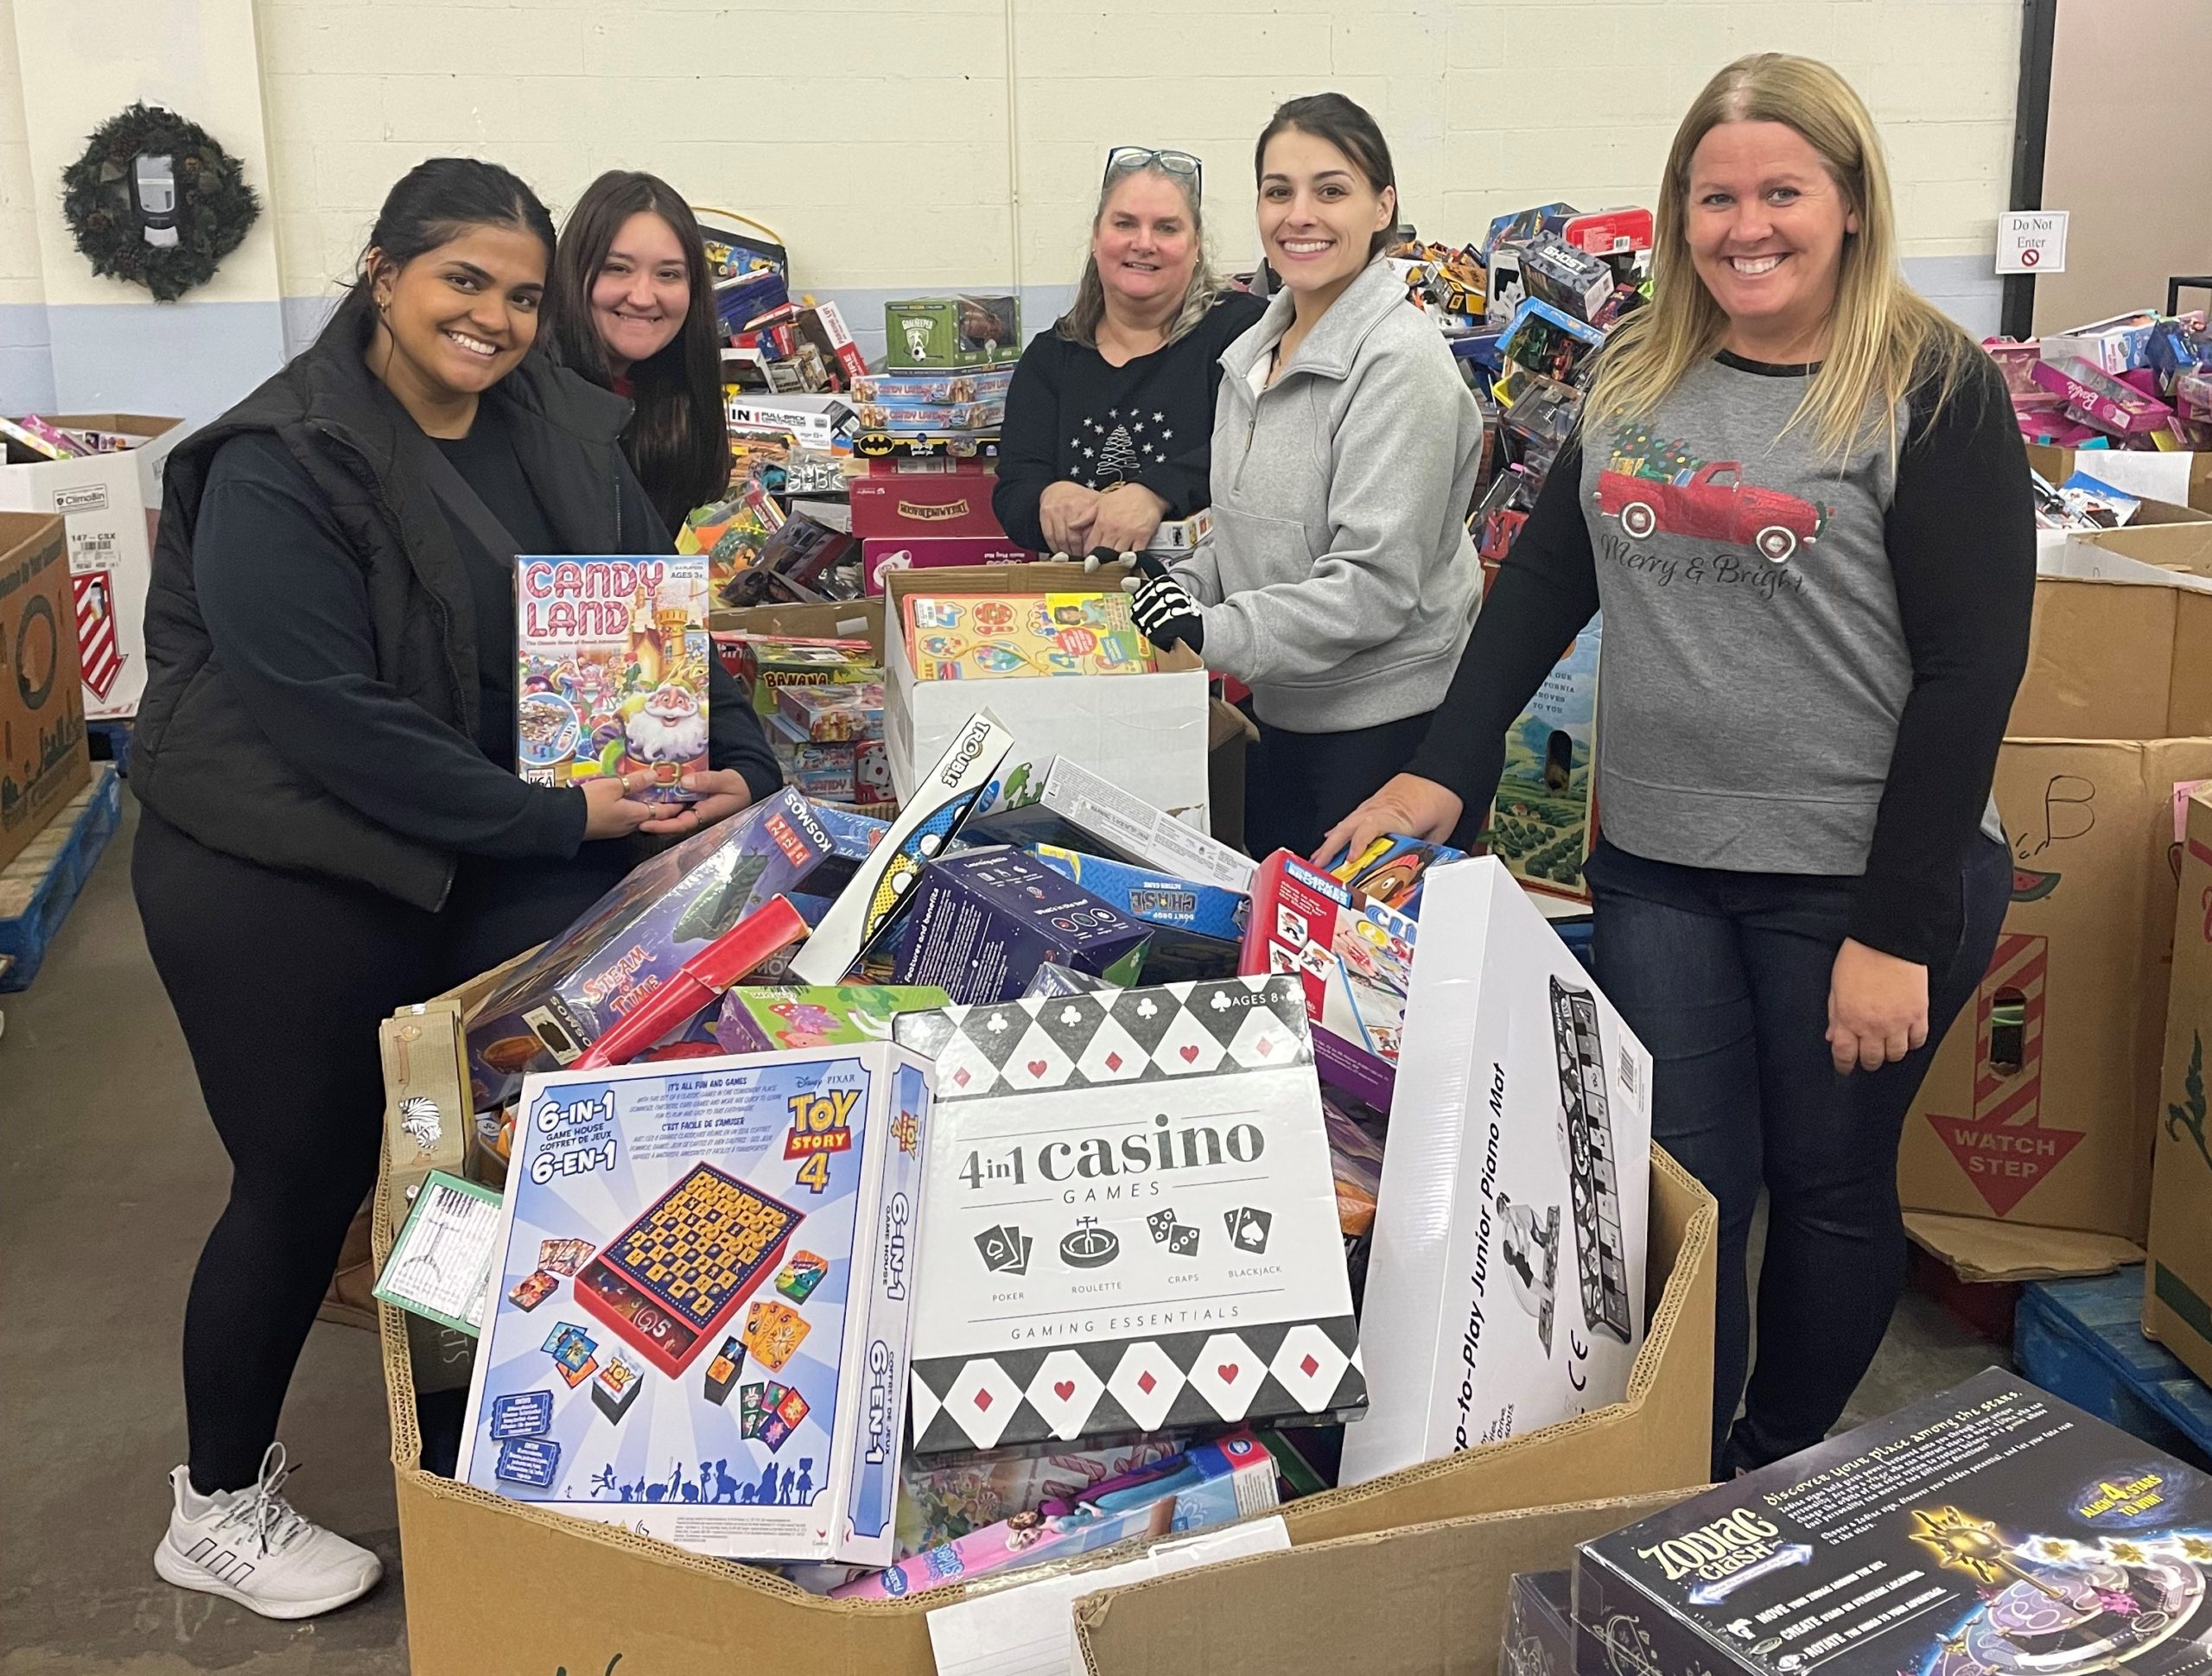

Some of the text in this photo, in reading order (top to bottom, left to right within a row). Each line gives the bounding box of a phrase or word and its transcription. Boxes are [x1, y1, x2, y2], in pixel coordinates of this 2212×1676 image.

[2012, 218, 2053, 232] Do Not
[2017, 236, 2046, 249] Enter
[1543, 244, 1588, 272] GHOST
[2066, 380, 2099, 411] Barbie
[732, 409, 806, 422] IN 1 PULL-BACK
[1601, 532, 1808, 600] Merry & Bright
[526, 562, 664, 599] CANDY
[526, 601, 630, 638] LAND
[764, 670, 829, 689] BANANA
[1533, 702, 1563, 714] TO YOU
[941, 721, 991, 789] TROUBLE
[784, 793, 832, 853] KOSMOS
[2044, 774, 2096, 848] B
[1130, 890, 1198, 913] CHASE
[905, 887, 940, 983] Features and benefits
[582, 944, 658, 1005] STEAM
[609, 974, 663, 1017] TIME
[1232, 992, 1267, 1006] AGES
[550, 996, 593, 1047] OSMOS
[681, 1081, 693, 1090] ALL
[696, 1080, 708, 1089] FUN
[709, 1079, 722, 1088] AND
[726, 1076, 747, 1086] GAMES
[795, 1074, 855, 1089] Disney PIXAR
[1491, 1063, 1506, 1113] Mat
[537, 1089, 615, 1133] 6-IN-1
[704, 1119, 713, 1127] DE
[787, 1089, 864, 1134] TOY
[540, 1131, 612, 1152] COFFRET DE JEUX
[546, 1123, 604, 1141] GAME HOUSE
[791, 1132, 847, 1152] STORY
[1955, 1128, 2056, 1157] WATCH
[531, 1139, 617, 1185] 6-EN-1
[1037, 1113, 1265, 1183] casino
[795, 1150, 831, 1195] 4
[1483, 1124, 1501, 1203] Piano
[1969, 1156, 2039, 1179] STEP
[1064, 1180, 1160, 1204] GAMES
[887, 1191, 909, 1302] 6-IN-1
[1471, 1204, 1493, 1298] Junior
[1167, 1273, 1199, 1285] CRAPS
[1228, 1264, 1282, 1278] BLACKJACK
[992, 1292, 1025, 1302] POKER
[1071, 1281, 1122, 1294] ROULETTE
[652, 1318, 672, 1337] 5
[1011, 1305, 1240, 1341] GAMING ESSENTIALS
[1567, 1328, 1588, 1392] CE
[865, 1339, 888, 1465] 6-EN-1
[887, 1408, 893, 1421] DE
[1868, 1439, 1910, 1462] place
[1910, 1418, 1960, 1442] among
[1955, 1408, 1980, 1421] the
[1980, 1391, 2023, 1412] stars.
[1942, 1468, 1972, 1482] hidden
[2079, 1474, 2163, 1518] ALIGN 4 STARS
[2118, 1505, 2140, 1517] TO
[1755, 1603, 1790, 1624] MOVE
[1780, 1616, 1822, 1641] CREATE
[1803, 1632, 1847, 1658] ROTATE
